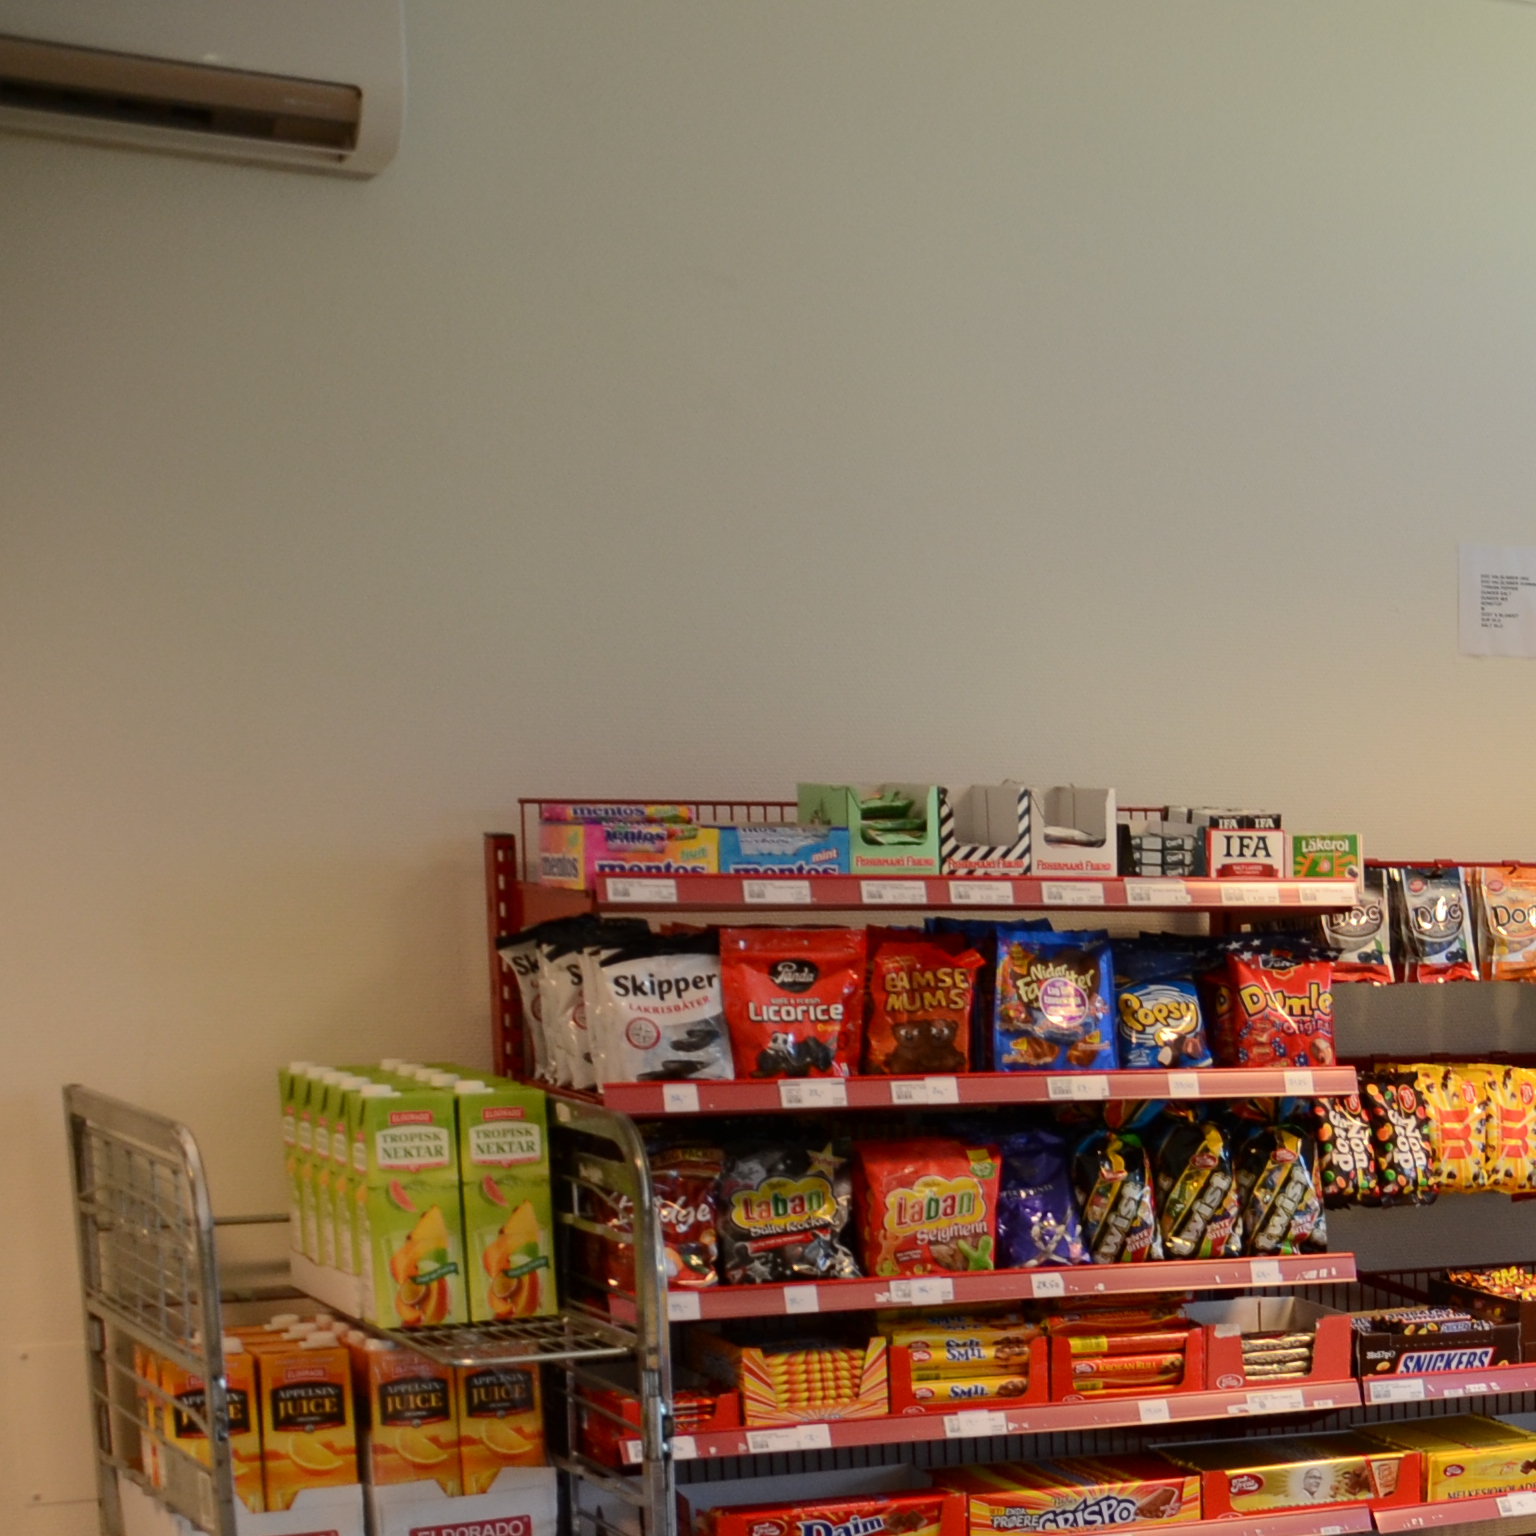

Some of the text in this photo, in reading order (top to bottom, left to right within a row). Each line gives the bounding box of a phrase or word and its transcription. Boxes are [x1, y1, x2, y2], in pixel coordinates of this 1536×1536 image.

[571, 806, 646, 818] mentos
[1218, 818, 1239, 829] IFA
[1254, 818, 1275, 829] IFA
[1222, 834, 1272, 858] IFA
[1301, 838, 1349, 853] Läkerol
[812, 849, 838, 862] mint
[906, 856, 935, 868] FRIEND
[996, 858, 1025, 869] FRIEND
[1085, 859, 1112, 871] FRIEND
[595, 860, 706, 873] mentos
[771, 962, 814, 984] Panda
[885, 967, 971, 992] BAMSE
[1030, 963, 1068, 982] Nidar
[614, 972, 718, 1001] Skipper
[628, 996, 710, 1015] LAKRISBÅTER
[886, 989, 966, 1012] MUMS
[1240, 982, 1333, 1017] Dumle
[1119, 992, 1198, 1036] Popsy
[382, 1132, 442, 1144] TROPISK
[475, 1128, 533, 1140] TROPISK
[380, 1145, 444, 1159] NEKTAR
[476, 1141, 536, 1155] NEKTAR
[742, 1189, 825, 1221] Laban
[895, 1188, 975, 1226] Laban
[916, 1220, 988, 1246] Seigmenn
[946, 1347, 987, 1362] SMIL
[1400, 1350, 1490, 1374] SNICKERS
[470, 1384, 526, 1403] JUICE
[948, 1385, 989, 1399] SMIL
[278, 1398, 338, 1419] JUICE
[386, 1392, 443, 1412] JUICE
